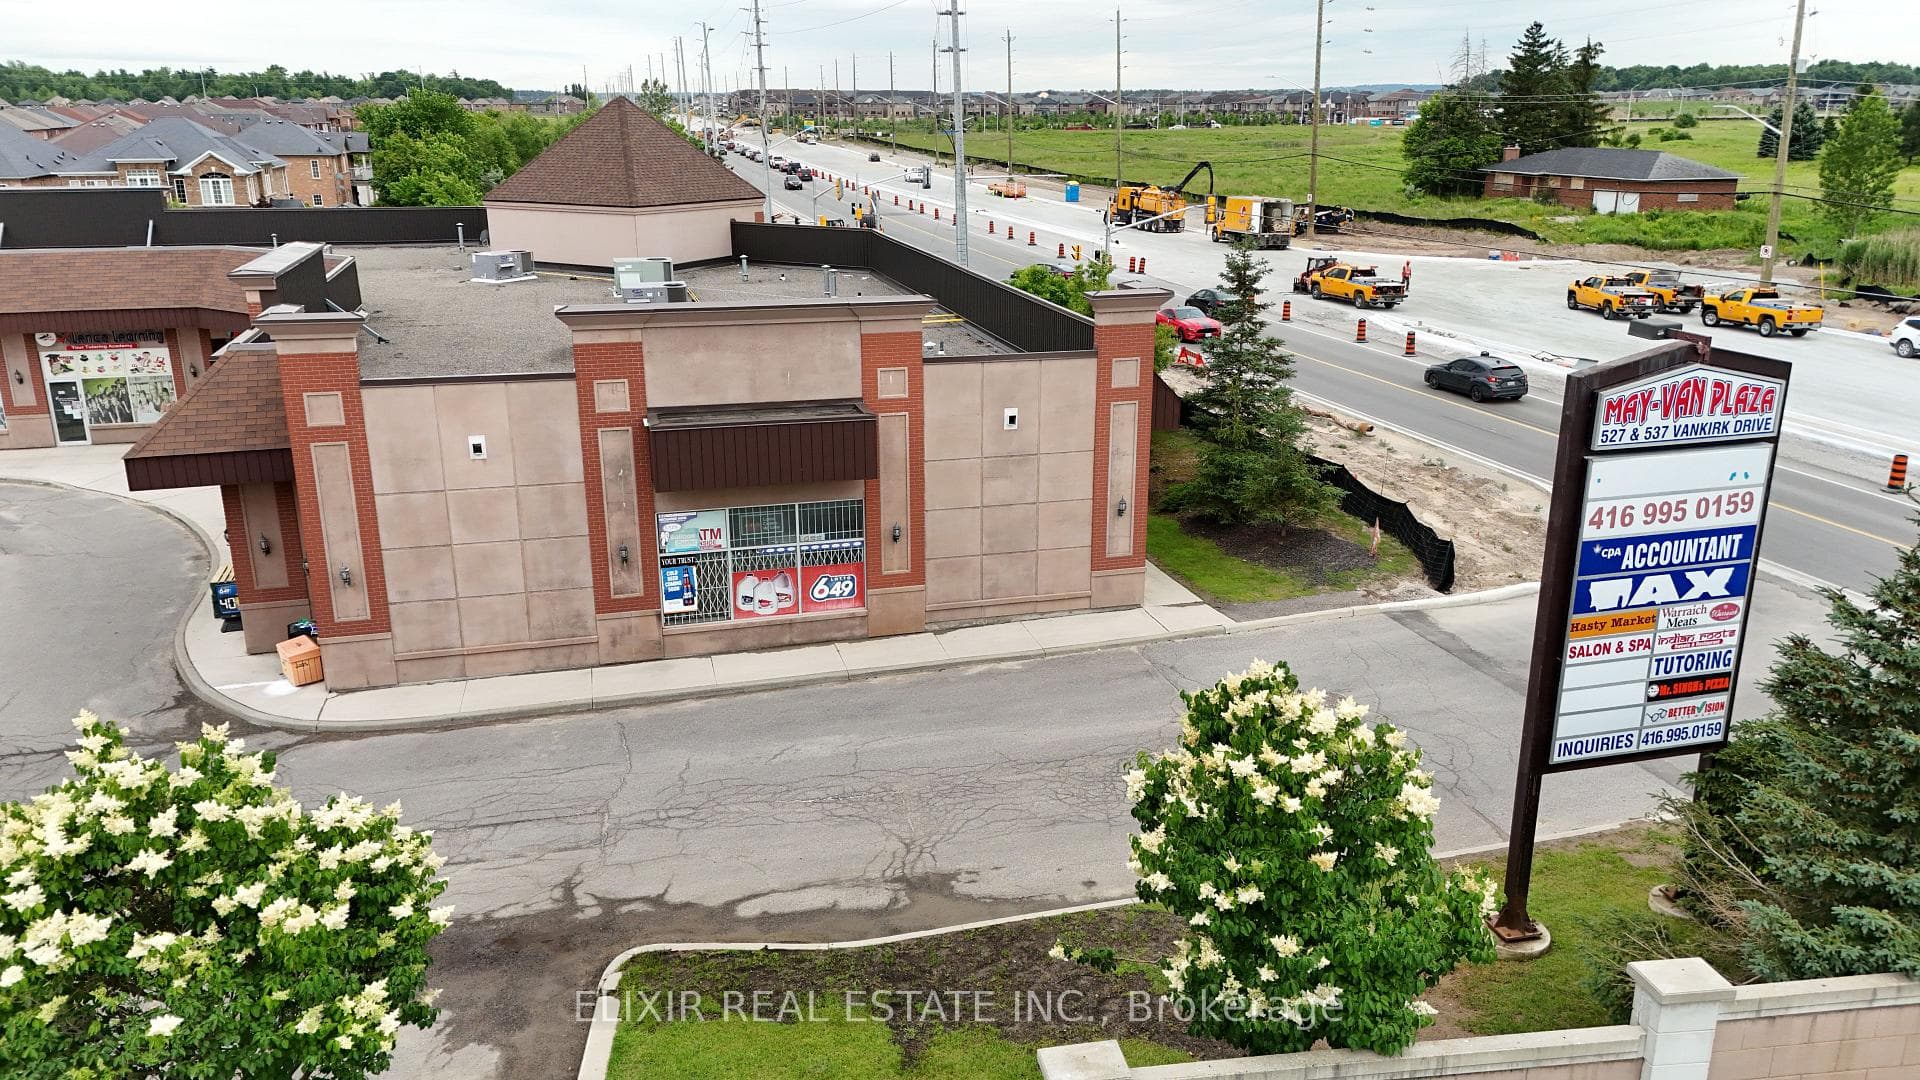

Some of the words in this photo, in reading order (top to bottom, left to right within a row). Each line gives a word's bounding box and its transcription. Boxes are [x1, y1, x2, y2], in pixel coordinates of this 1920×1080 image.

[1602, 377, 1707, 426] MAY-VAN
[1708, 378, 1776, 417] PLAZA
[1601, 428, 1626, 443] 527
[1630, 427, 1640, 441] &
[1644, 426, 1669, 440] 537
[1673, 420, 1730, 438] VANKIRK
[1734, 417, 1773, 433] DRIVE
[1588, 505, 1635, 530] 416
[1642, 499, 1688, 525] 995
[1695, 490, 1755, 519] 0159
[1620, 533, 1744, 570] ACCOUNTANT
[1662, 604, 1707, 618] Warraich
[1666, 617, 1698, 629] Meats
[1570, 620, 1607, 633] Hasty
[1610, 614, 1657, 628] Market
[1568, 642, 1611, 660] SALON
[1615, 640, 1624, 653] &
[1628, 637, 1651, 652] SPA
[1654, 649, 1733, 676] TUTORING
[1705, 677, 1730, 690] PIZZA
[1668, 705, 1696, 718] BETTER
[1641, 721, 1722, 746] 416.995.0159
[1557, 734, 1634, 758] INQUIRIES
